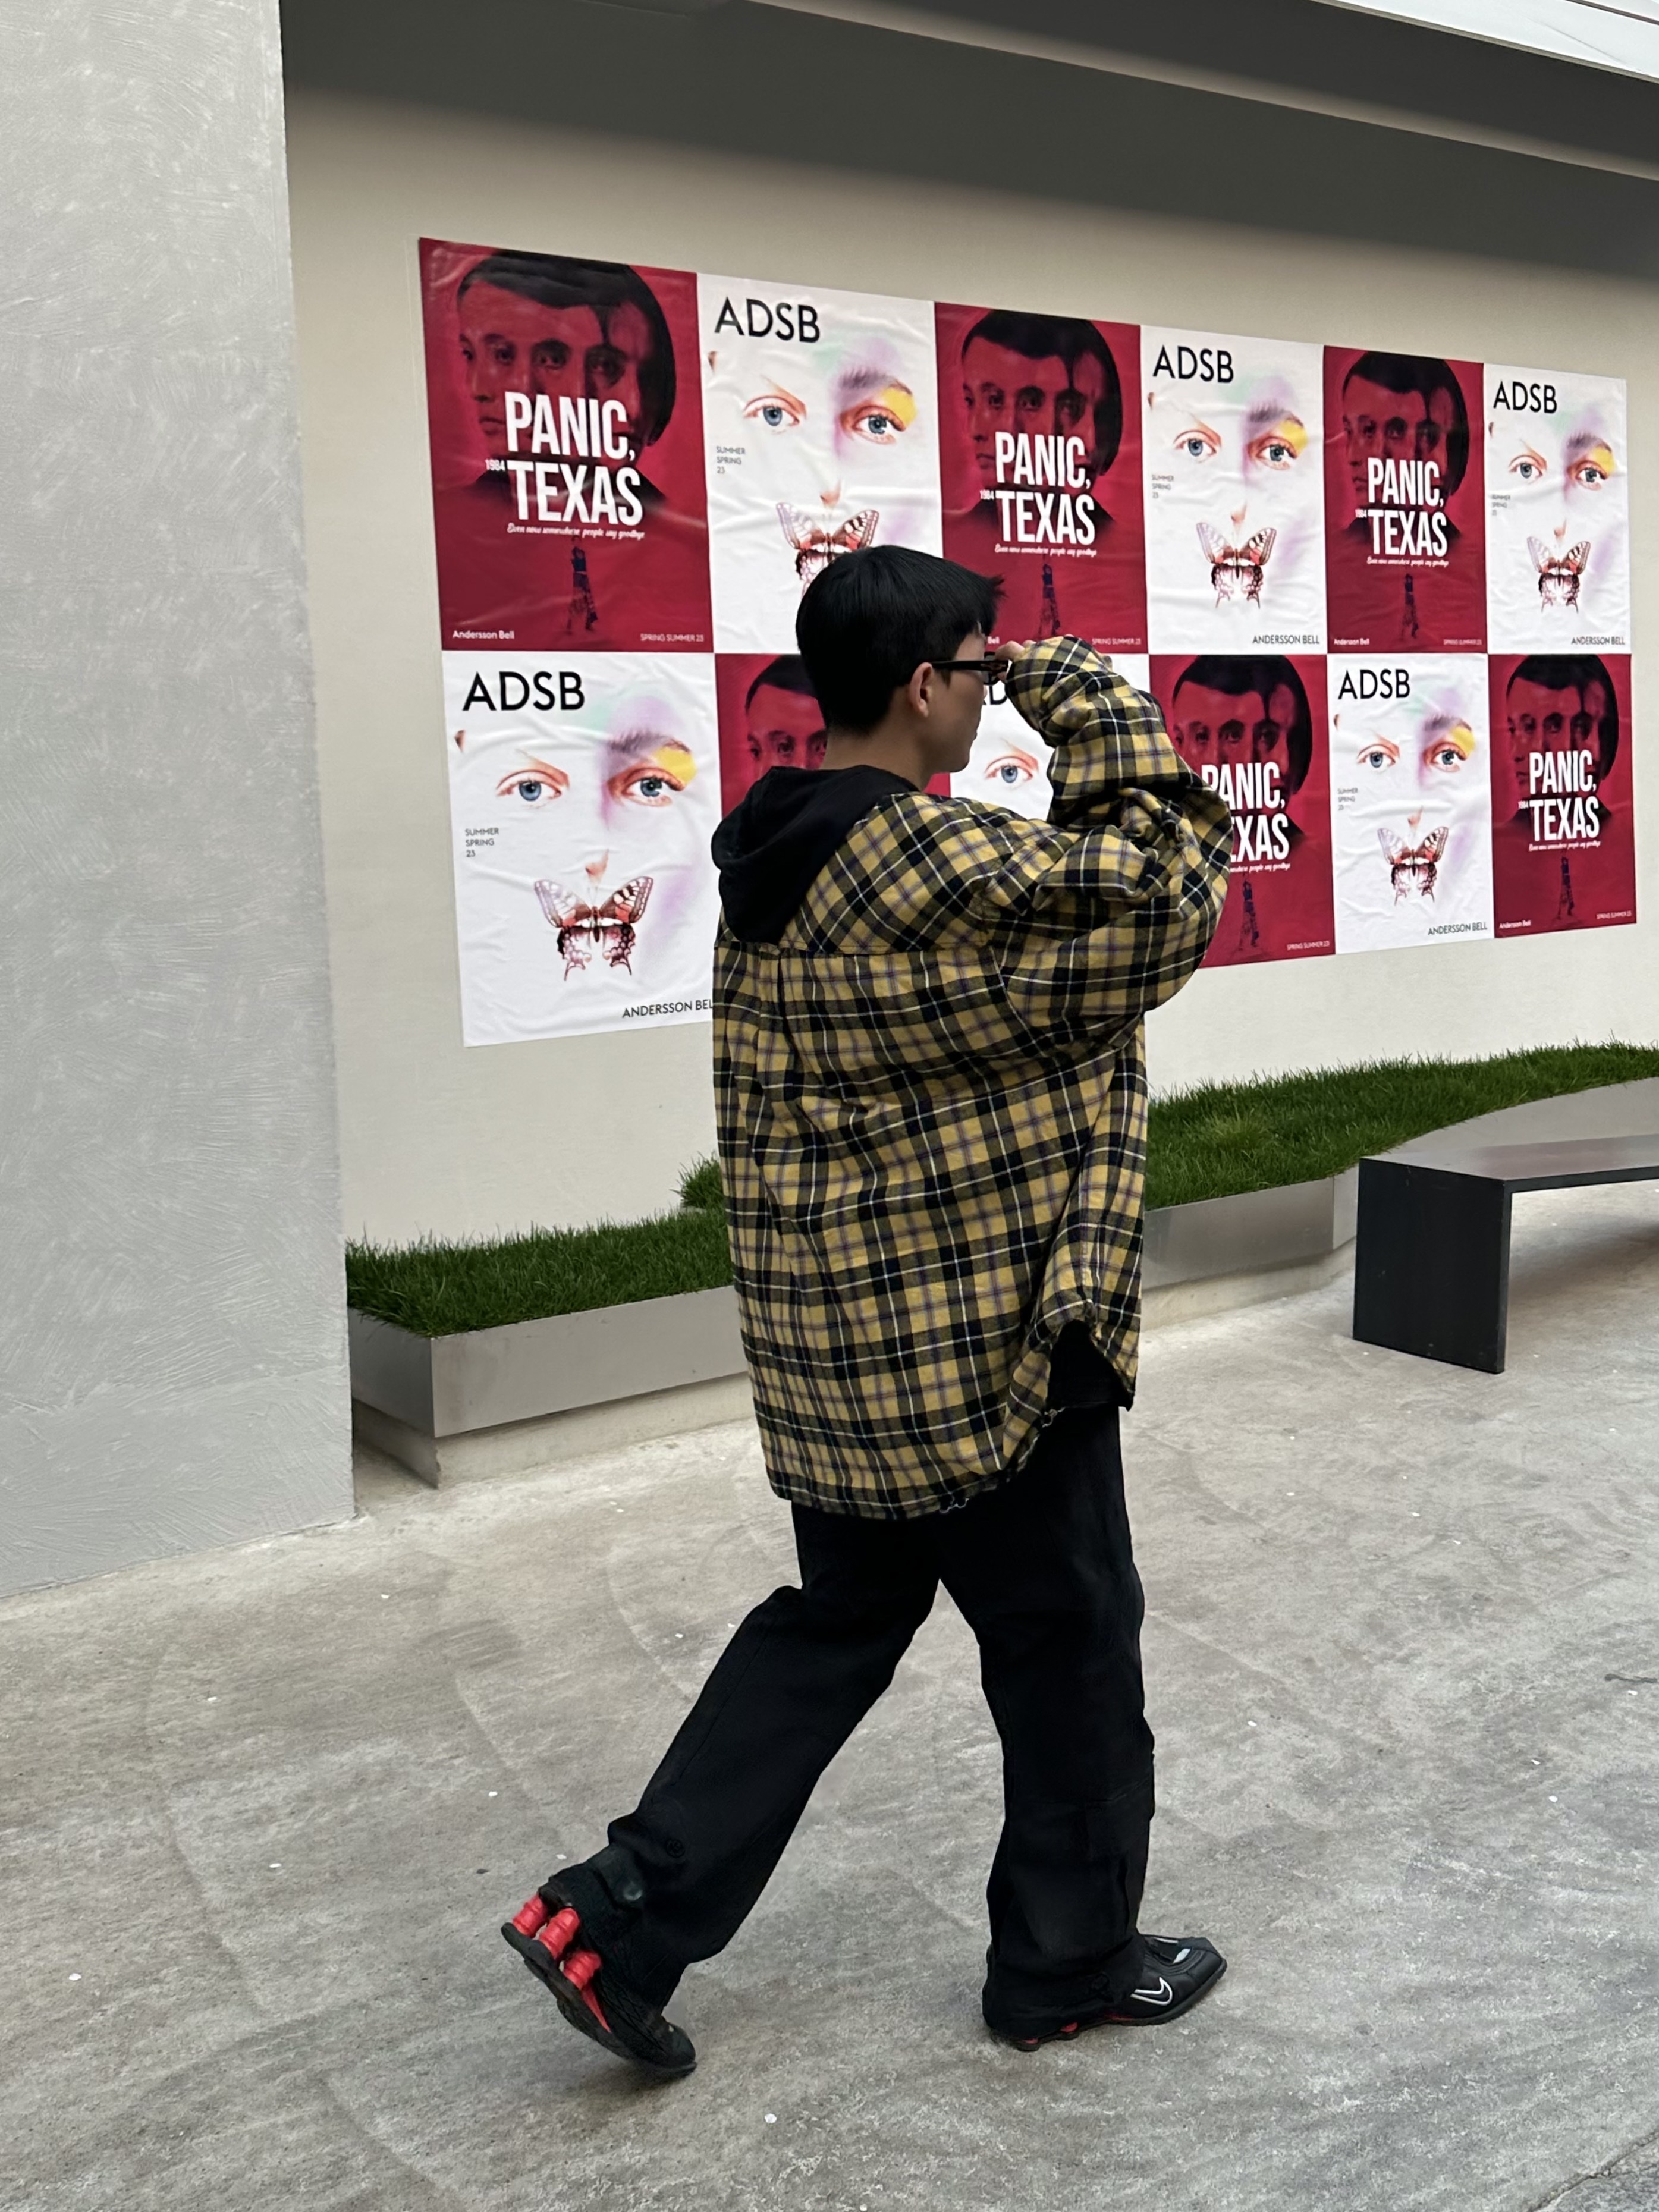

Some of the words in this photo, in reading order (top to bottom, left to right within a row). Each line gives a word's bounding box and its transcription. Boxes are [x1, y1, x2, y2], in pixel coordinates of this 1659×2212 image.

[714, 296, 820, 343] ADSB
[1152, 344, 1234, 383] ADSB
[1493, 380, 1557, 414] ADSB
[505, 391, 636, 461] PANIC,
[485, 458, 505, 472] 1984
[716, 446, 746, 455] SUMMER
[717, 456, 742, 465] SPRING
[995, 431, 1091, 489] PANIC,
[507, 460, 643, 526] TEXAS
[1368, 457, 1444, 507] PANIC,
[582, 528, 604, 538] people
[995, 490, 1095, 545] TEXAS
[1368, 509, 1447, 557] TEXAS
[453, 630, 497, 639] Andersson
[499, 630, 515, 639] Bell
[640, 633, 665, 642] SPRING
[667, 634, 695, 642] SUMMER
[1252, 634, 1300, 644] ANDERSSON
[1302, 635, 1320, 644] BELL
[1571, 636, 1610, 645] ANDERSSON
[1611, 636, 1625, 645] BELL
[463, 671, 585, 711] ADSB
[1338, 668, 1410, 699] ADSB
[1201, 761, 1286, 810] PANIC,
[1529, 749, 1597, 794] PANIC,
[465, 827, 499, 836] SUMMER
[1529, 796, 1600, 841] TEXAS
[466, 838, 495, 847] SPRING
[466, 849, 476, 857] 23
[1230, 813, 1290, 863] XAS
[1428, 923, 1471, 935] ANDERSSON
[1472, 922, 1488, 931] BELL
[622, 1001, 692, 1018] ANDERSSON
[696, 999, 712, 1010] BEL
